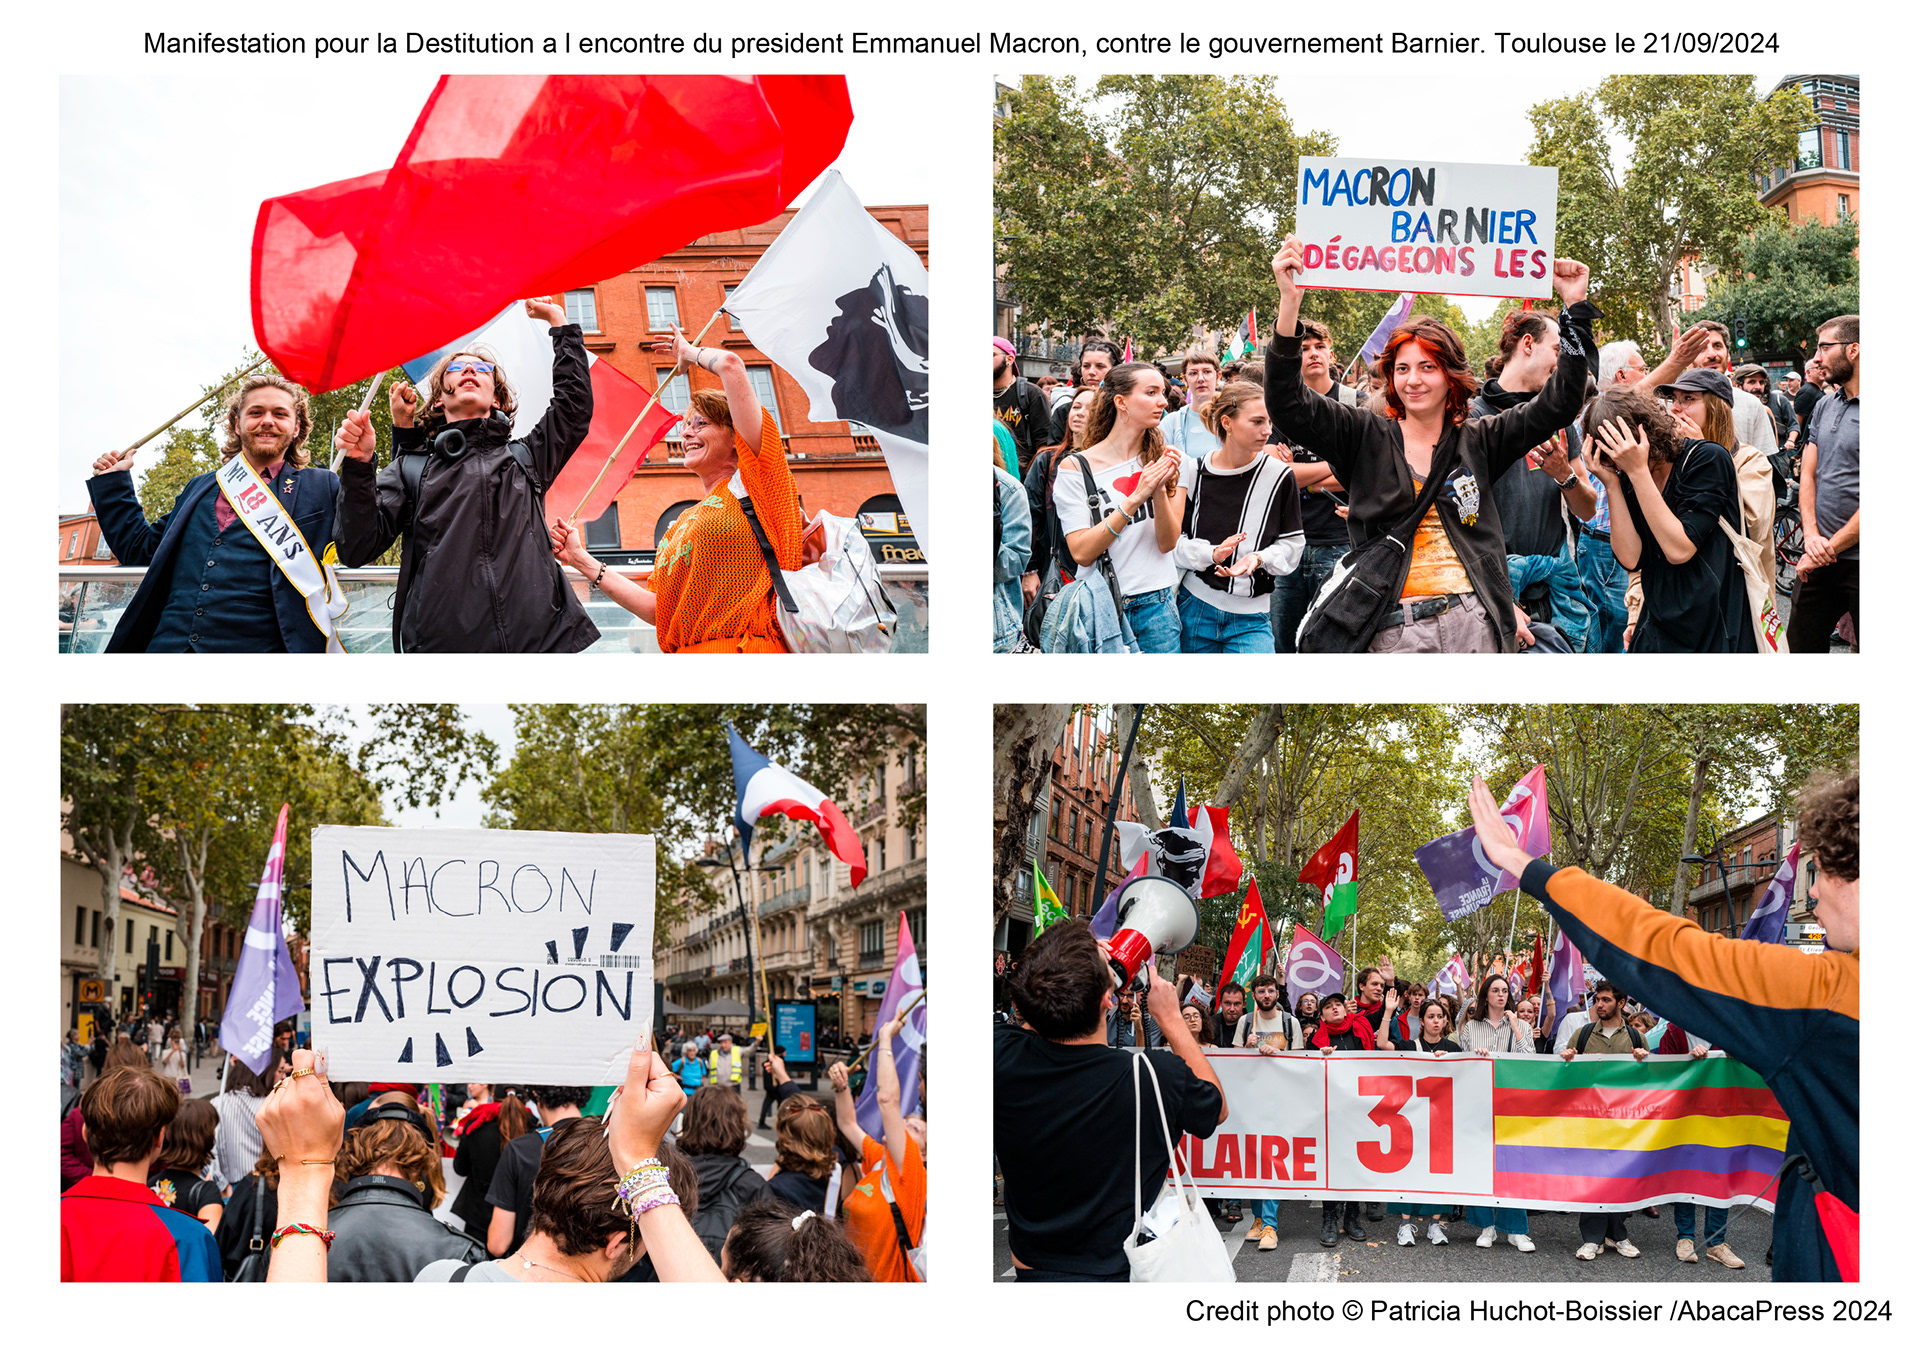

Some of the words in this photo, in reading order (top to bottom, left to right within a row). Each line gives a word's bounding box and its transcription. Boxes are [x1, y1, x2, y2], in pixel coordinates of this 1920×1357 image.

[1302, 166, 1436, 207] MACRON
[1391, 207, 1538, 245] BARNIER
[1303, 235, 1475, 276] DÉGAGEONS
[1494, 248, 1547, 279] LES
[239, 482, 268, 511] 18
[256, 515, 304, 560] ANS
[343, 850, 596, 923] MACRON
[1182, 965, 1213, 975] BARNIER
[1184, 960, 1214, 970] CONTRE
[320, 956, 634, 1024] EXPLOSION
[1357, 1075, 1454, 1175] 31
[372, 1175, 386, 1184] JBL
